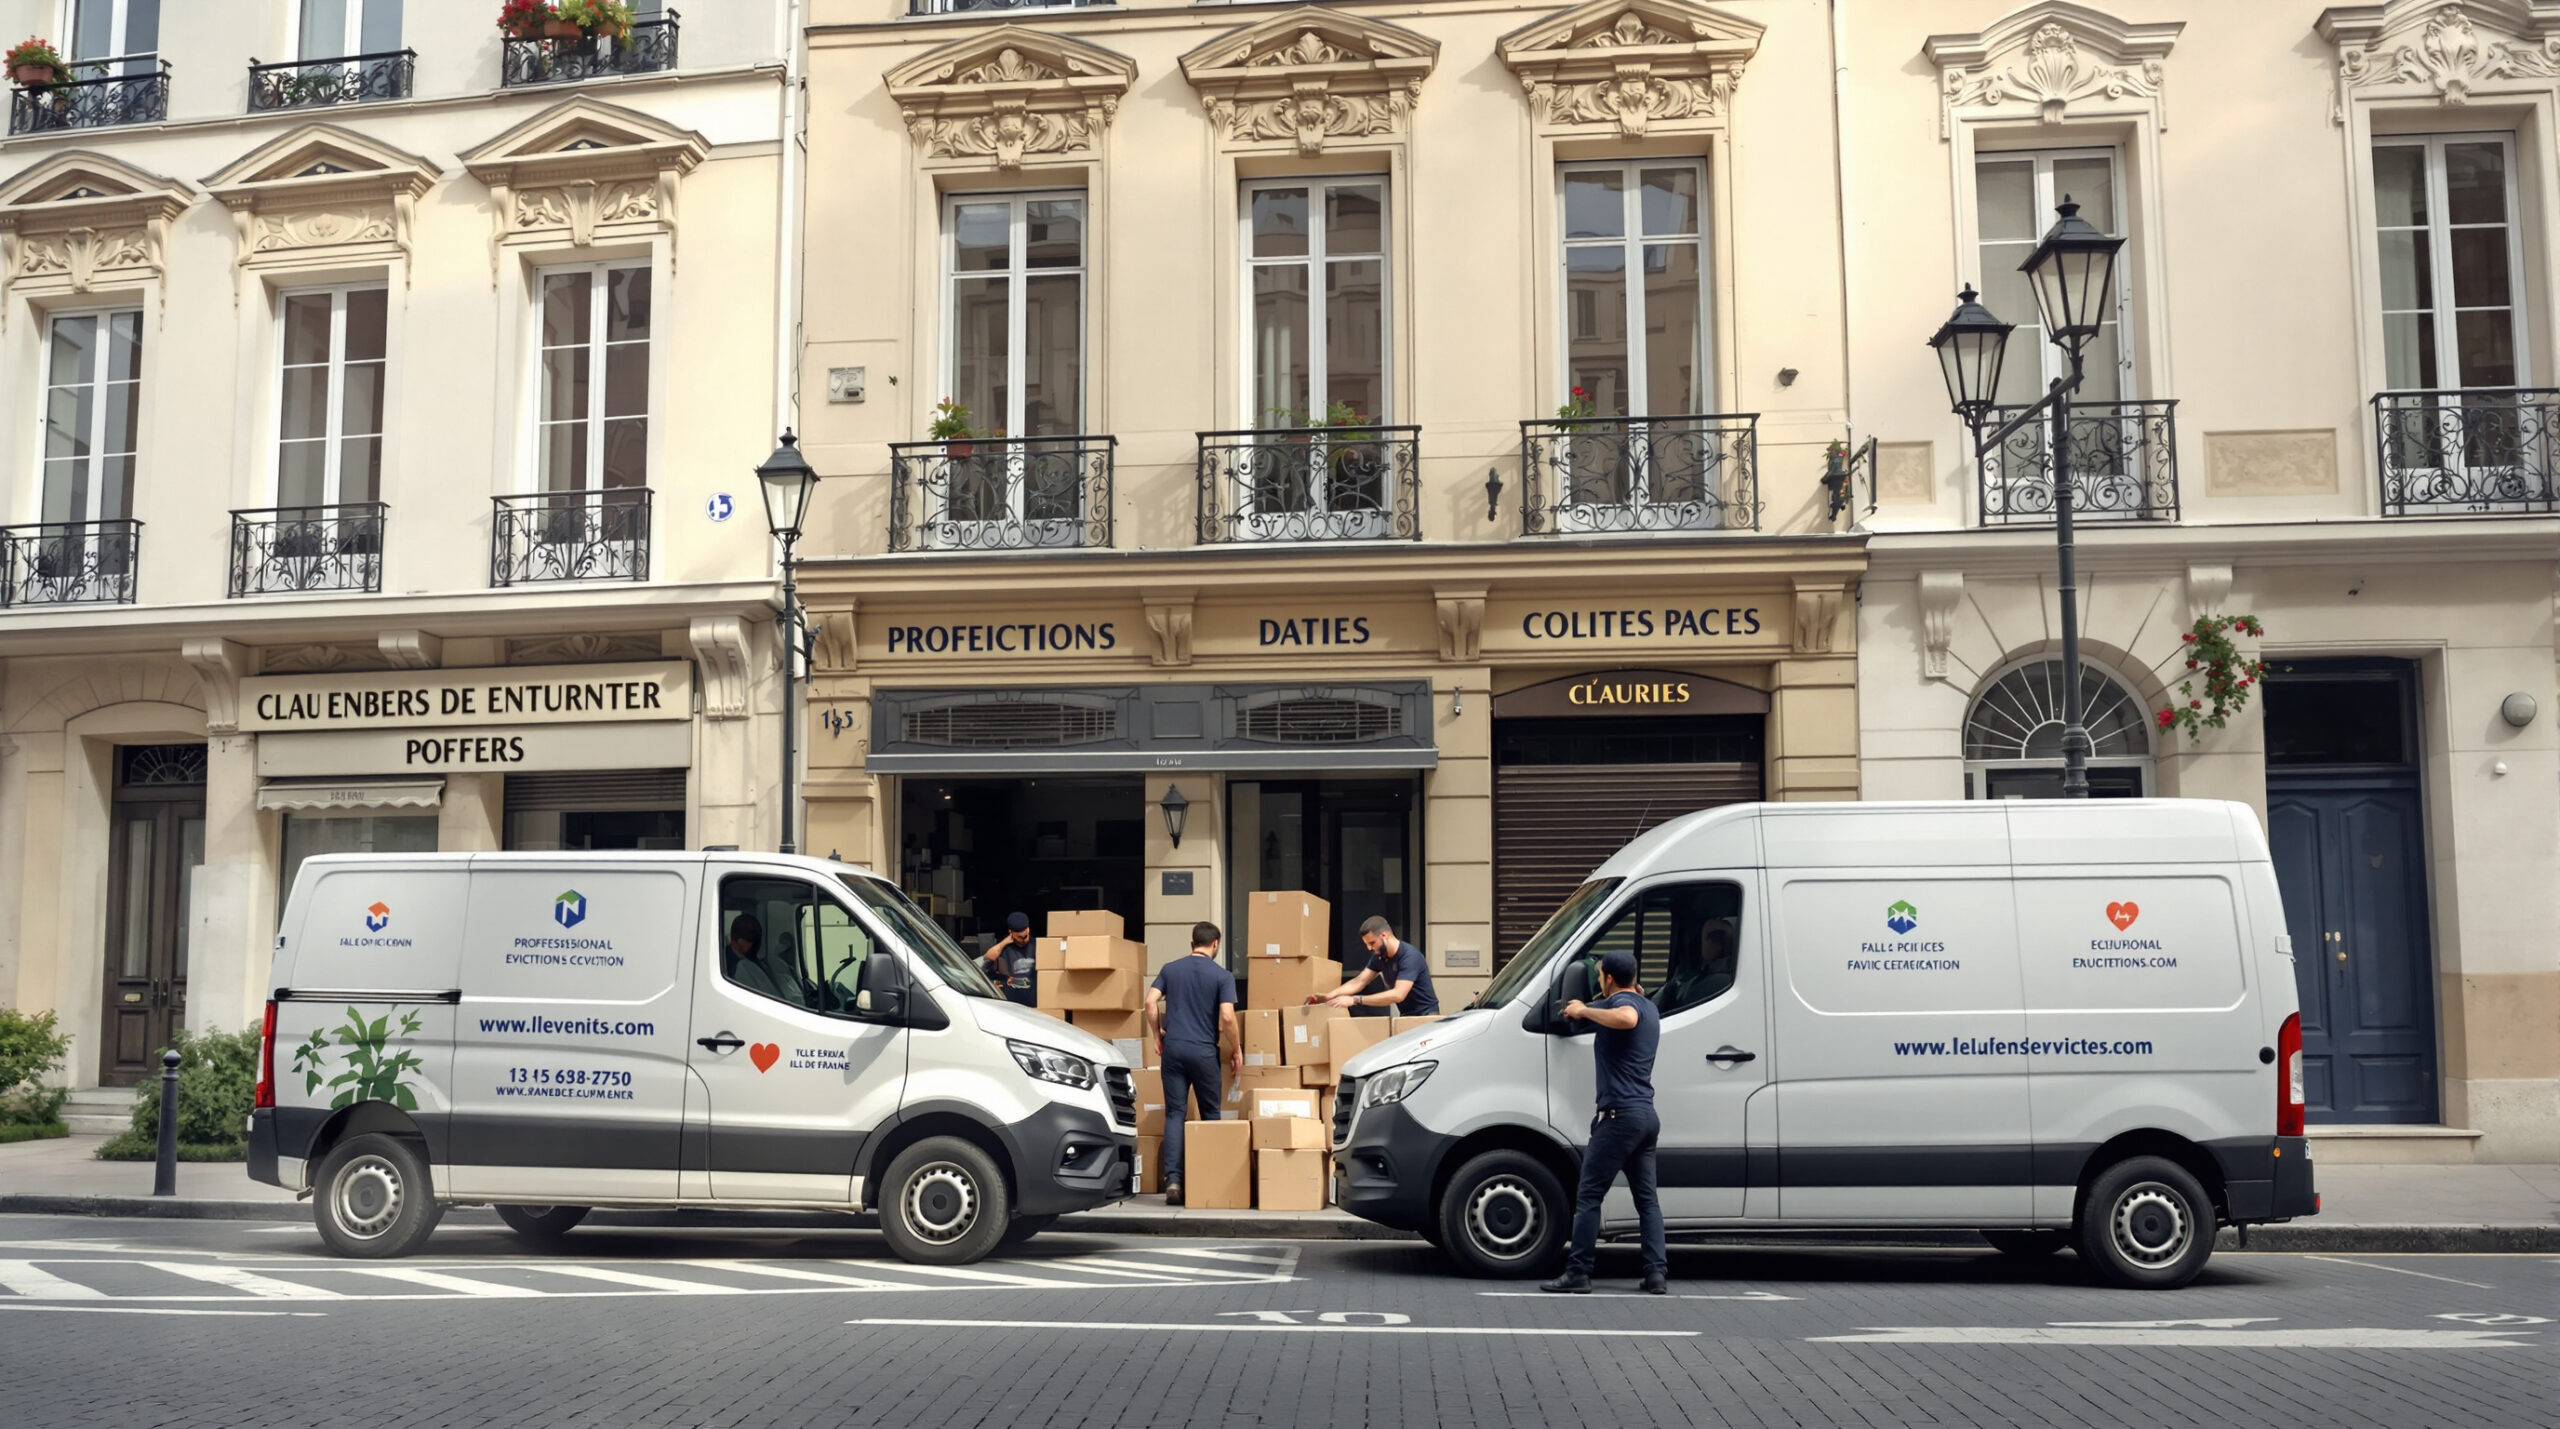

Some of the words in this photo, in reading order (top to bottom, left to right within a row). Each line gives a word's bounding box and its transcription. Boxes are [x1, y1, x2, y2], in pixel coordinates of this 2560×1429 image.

[888, 623, 1115, 653] PROFEICTIONS
[1259, 616, 1370, 646] DATIES
[1522, 609, 1654, 639] COLITES
[440, 687, 477, 715] DE
[488, 682, 662, 714] ENTURNTER
[406, 737, 524, 765] POFFERS
[479, 1016, 655, 1037] www.llevenits.com
